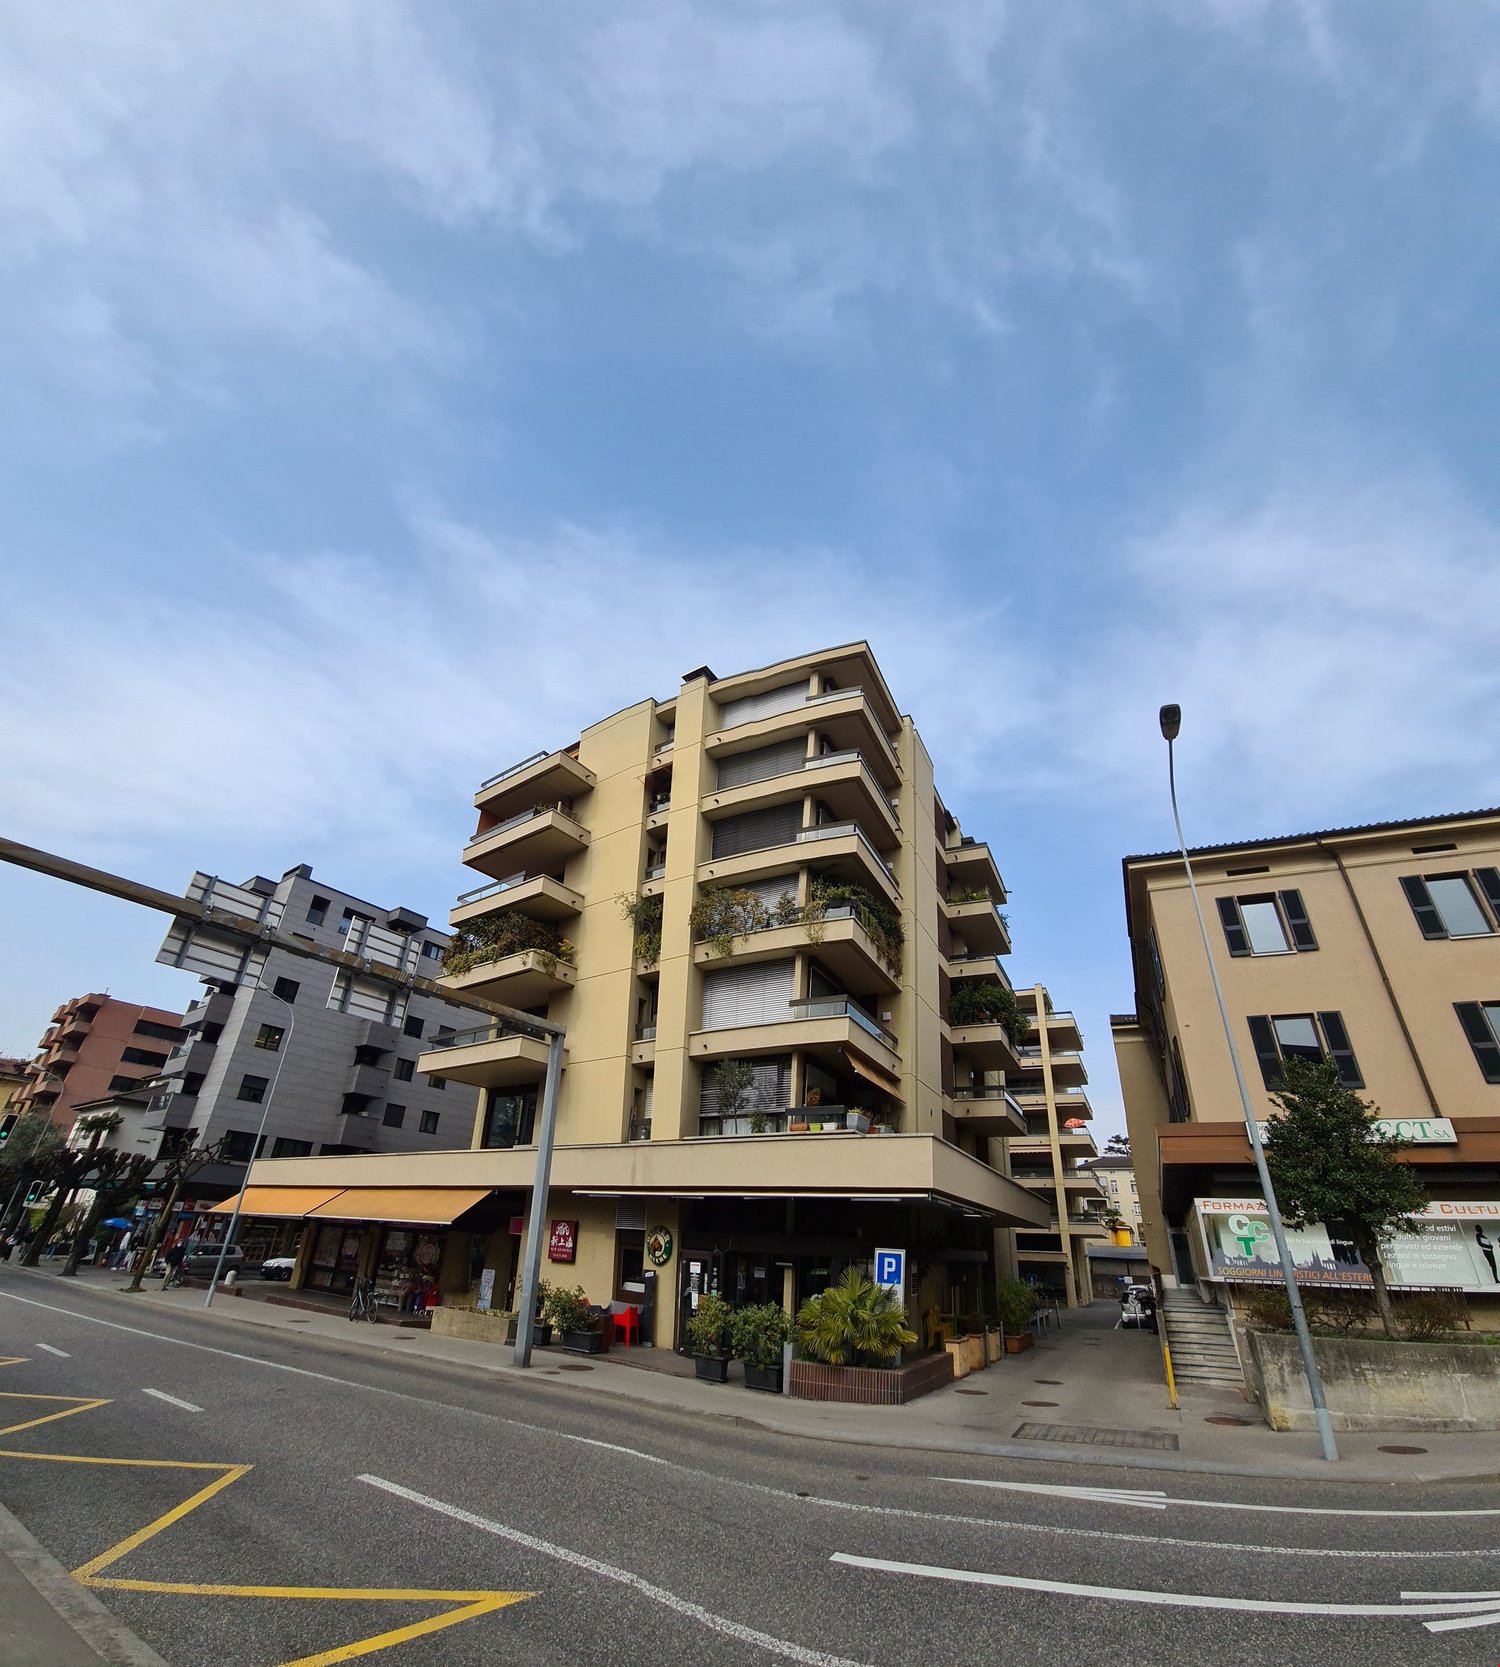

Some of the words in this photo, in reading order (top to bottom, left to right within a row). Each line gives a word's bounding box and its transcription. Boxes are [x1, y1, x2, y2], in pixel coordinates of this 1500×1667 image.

[1375, 1121, 1432, 1139] CCT
[1434, 1129, 1451, 1138] SA
[1202, 1200, 1267, 1211] FORMAZ
[1436, 1224, 1457, 1232] estivi
[1336, 1239, 1354, 1247] lingue
[1422, 1233, 1452, 1243] giovani
[1394, 1243, 1419, 1251] privati
[1433, 1243, 1464, 1251] aziende
[883, 1257, 897, 1280] P
[1218, 1267, 1266, 1277] SOGGIORNI
[1269, 1268, 1320, 1280] LINISTICI
